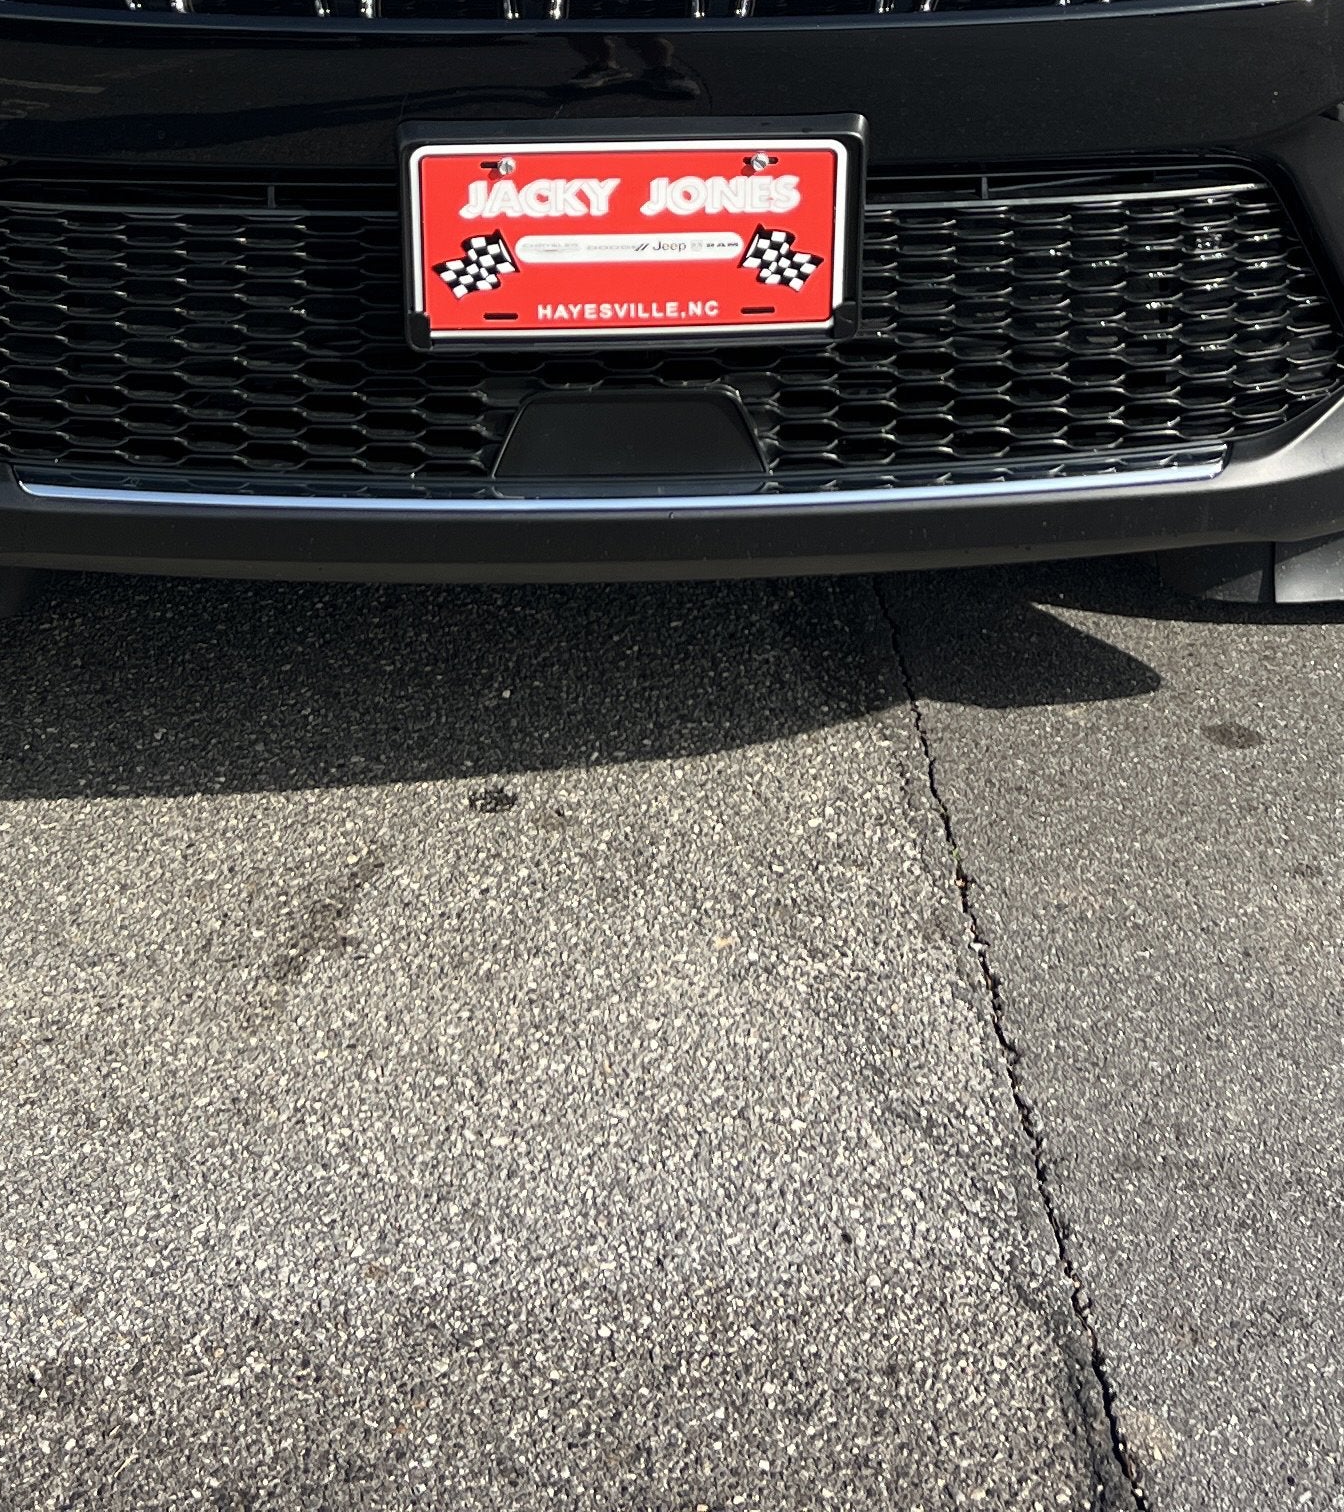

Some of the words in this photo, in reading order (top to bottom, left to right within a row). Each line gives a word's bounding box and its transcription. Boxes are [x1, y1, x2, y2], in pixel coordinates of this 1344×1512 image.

[459, 178, 620, 220] JACKY
[639, 175, 801, 216] JONES
[652, 240, 687, 253] Jeep
